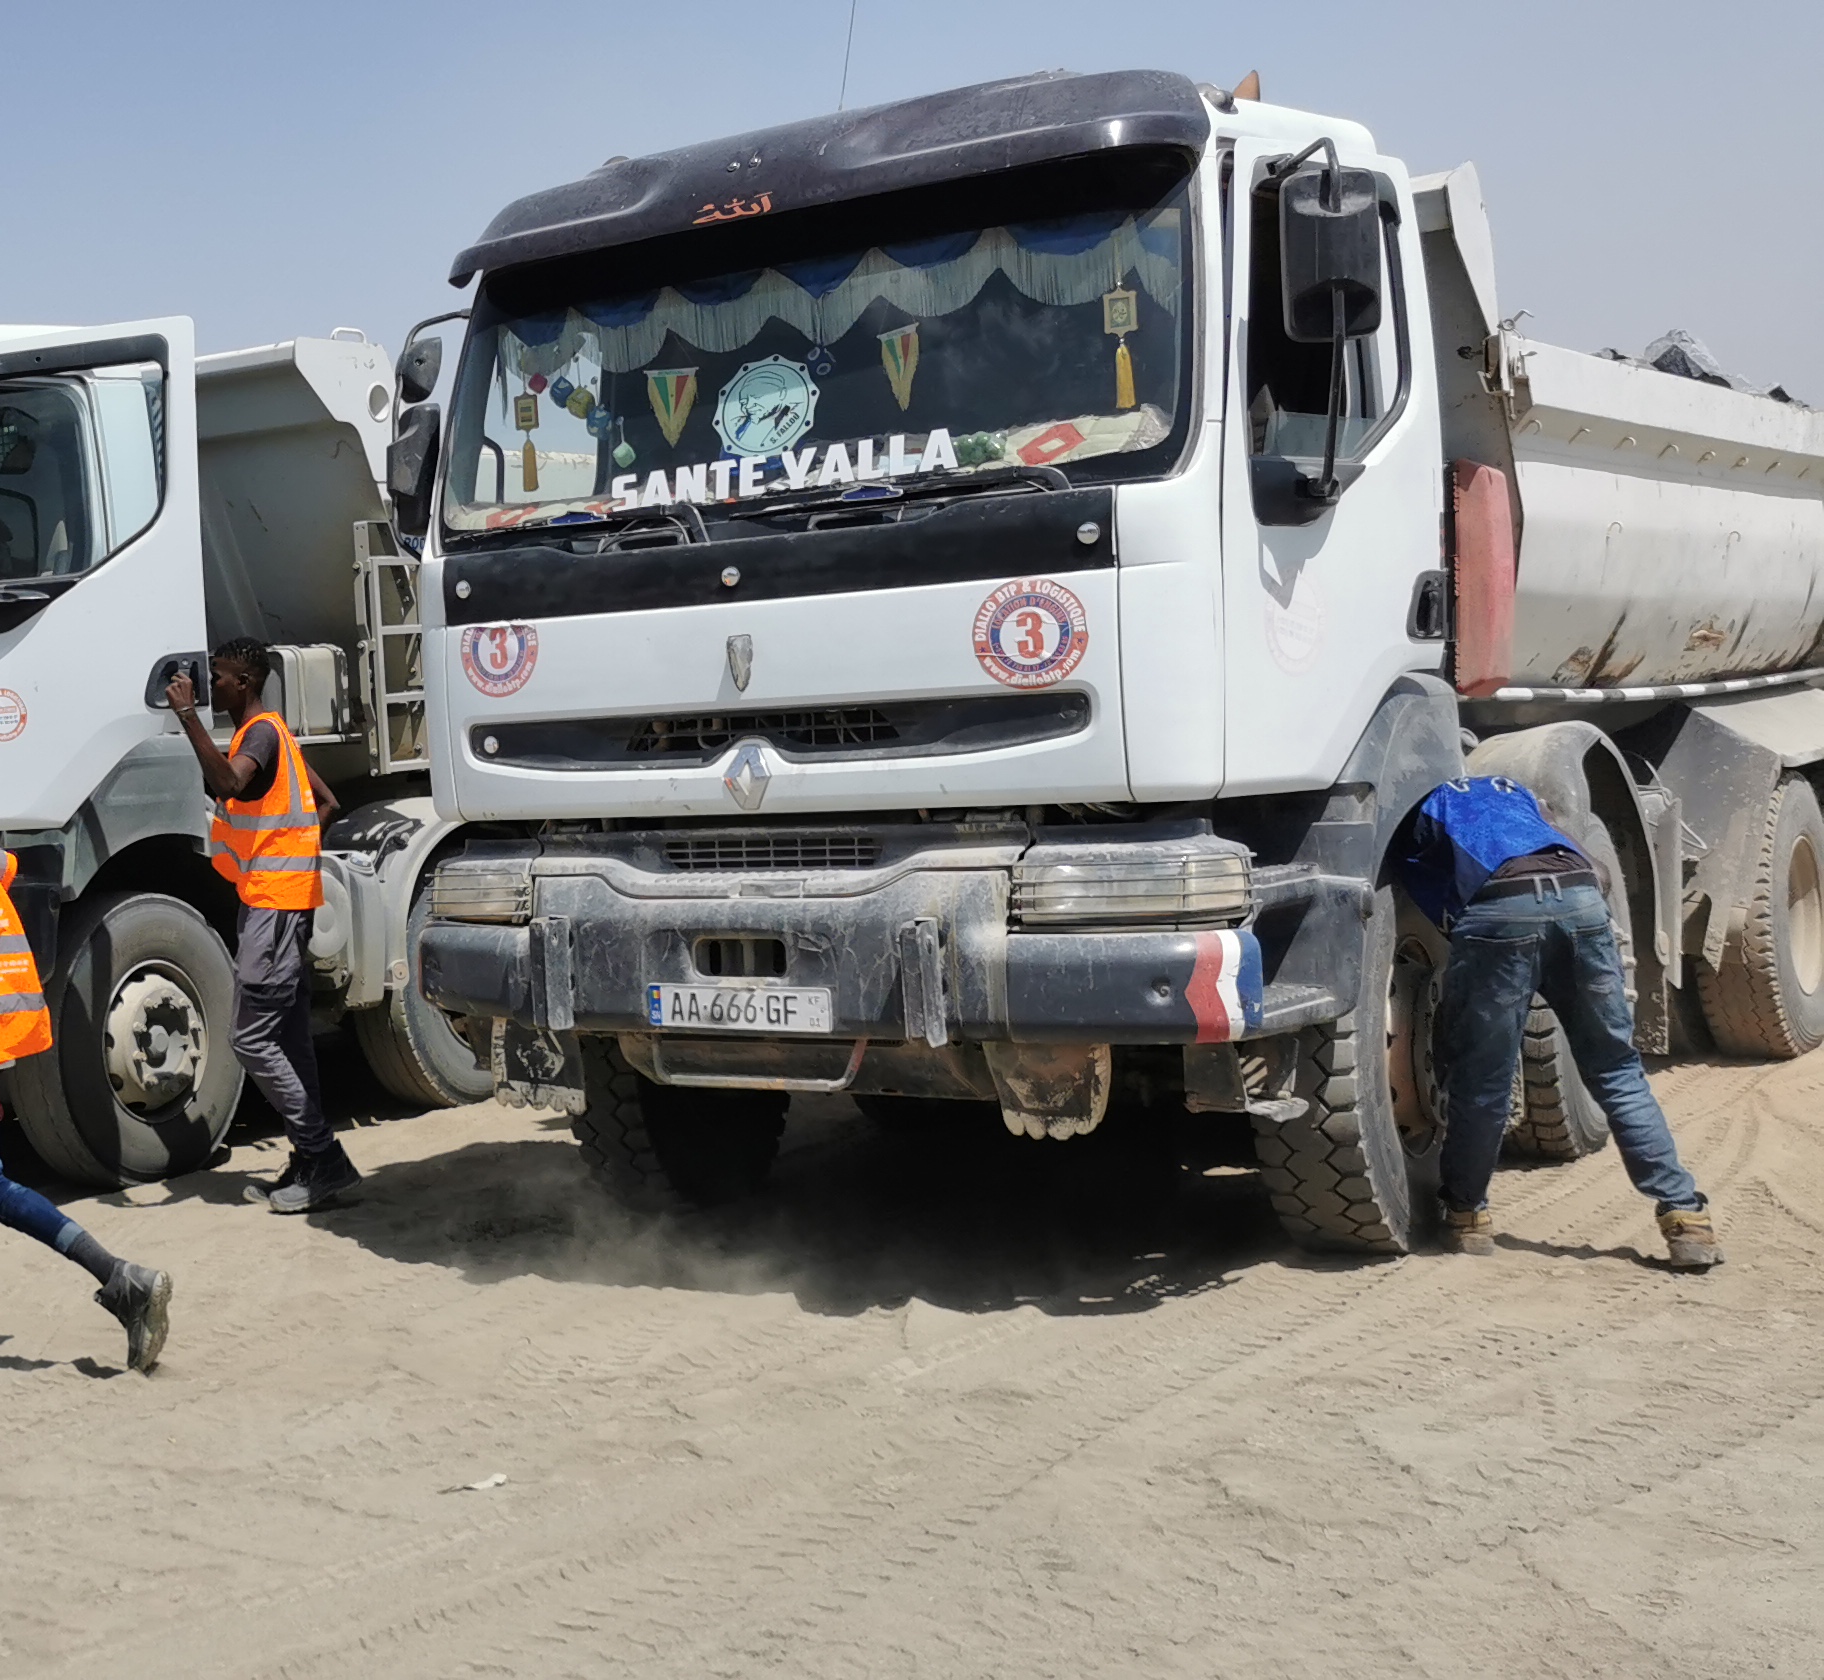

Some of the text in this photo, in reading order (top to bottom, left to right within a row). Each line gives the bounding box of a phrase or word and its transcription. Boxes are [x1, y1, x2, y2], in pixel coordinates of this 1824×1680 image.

[611, 428, 959, 512] SANTE YALLA
[974, 580, 1086, 641] DIALLO BTP & LOGISTIQUE
[1016, 611, 1044, 658] 3
[489, 628, 508, 669] 3
